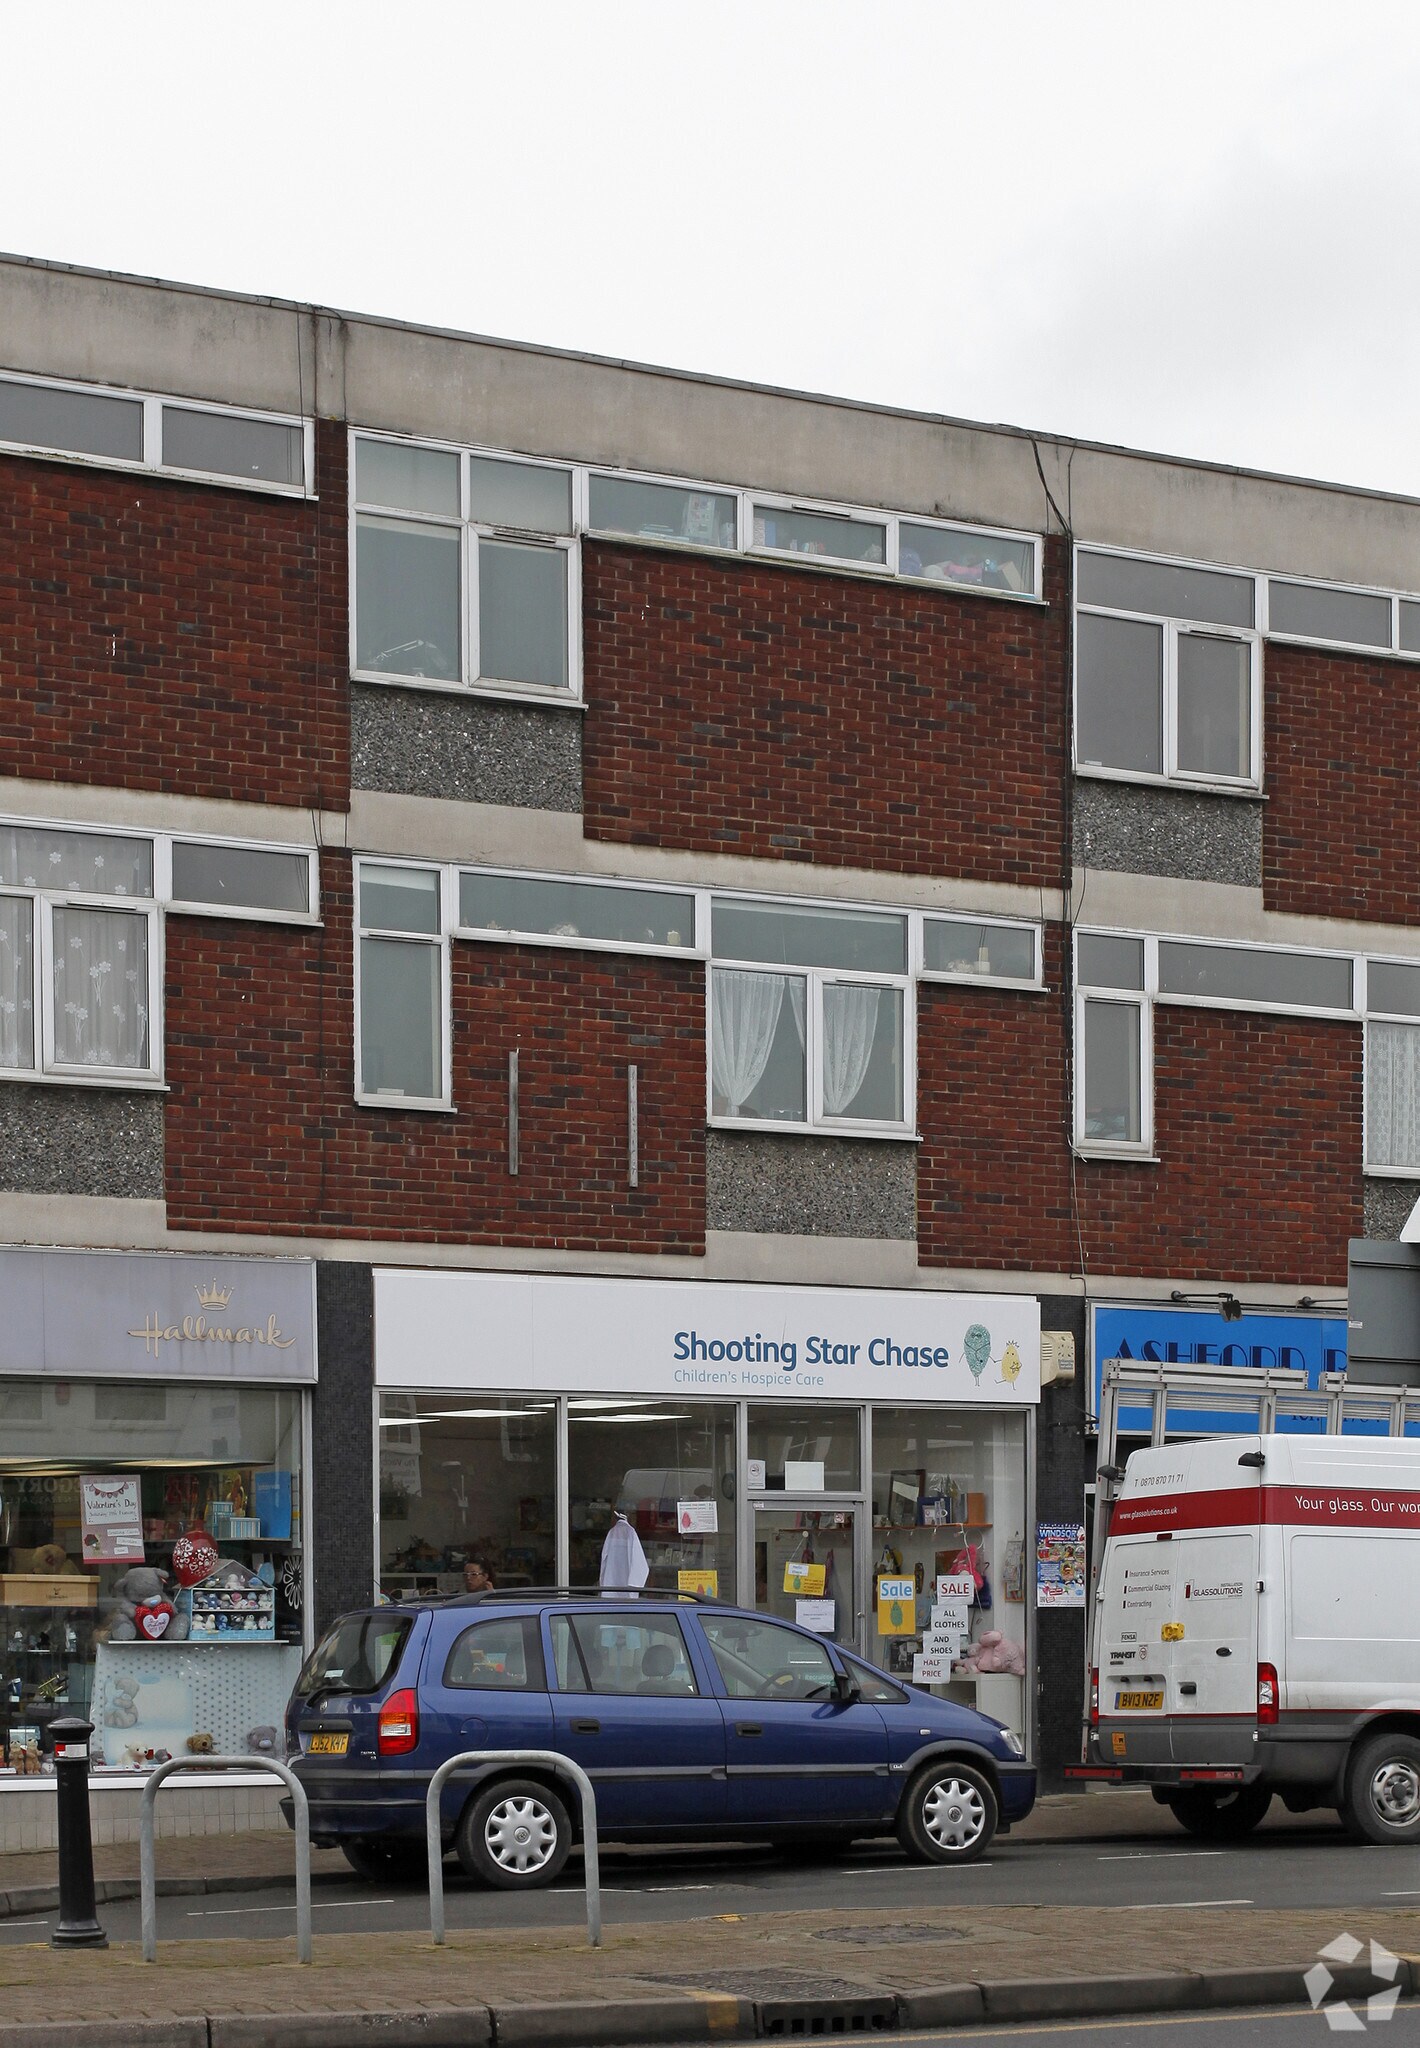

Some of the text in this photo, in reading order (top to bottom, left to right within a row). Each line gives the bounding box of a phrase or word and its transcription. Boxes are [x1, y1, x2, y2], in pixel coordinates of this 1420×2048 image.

[128, 1311, 296, 1358] Hallmark
[673, 1331, 949, 1371] Shooting Star Chase
[674, 1369, 824, 1387] Children's Hospice Care
[1140, 1476, 1155, 1487] 0870
[1155, 1475, 1167, 1485] 870
[1167, 1474, 1175, 1484] 71
[1176, 1473, 1184, 1483] 71
[86, 1498, 137, 1510] Valentine's Day
[1295, 1495, 1325, 1510] Your
[1328, 1497, 1368, 1514] glass.
[1371, 1498, 1395, 1512] Our
[1039, 1529, 1078, 1538] WINDSOR
[1151, 1568, 1170, 1576] Services
[881, 1582, 912, 1597] Sale
[941, 1583, 970, 1595] SALE
[1128, 1584, 1171, 1593] Commercial Glazing
[1193, 1587, 1243, 1597] GLASSOLUTIONS
[1127, 1601, 1152, 1609] Contracting
[934, 1621, 965, 1629] CLOTHES
[930, 1647, 953, 1655] SHOES
[1110, 1651, 1136, 1659] TRANSIT
[922, 1670, 942, 1678] PRICE
[1122, 1693, 1160, 1707] BV13 NZF
